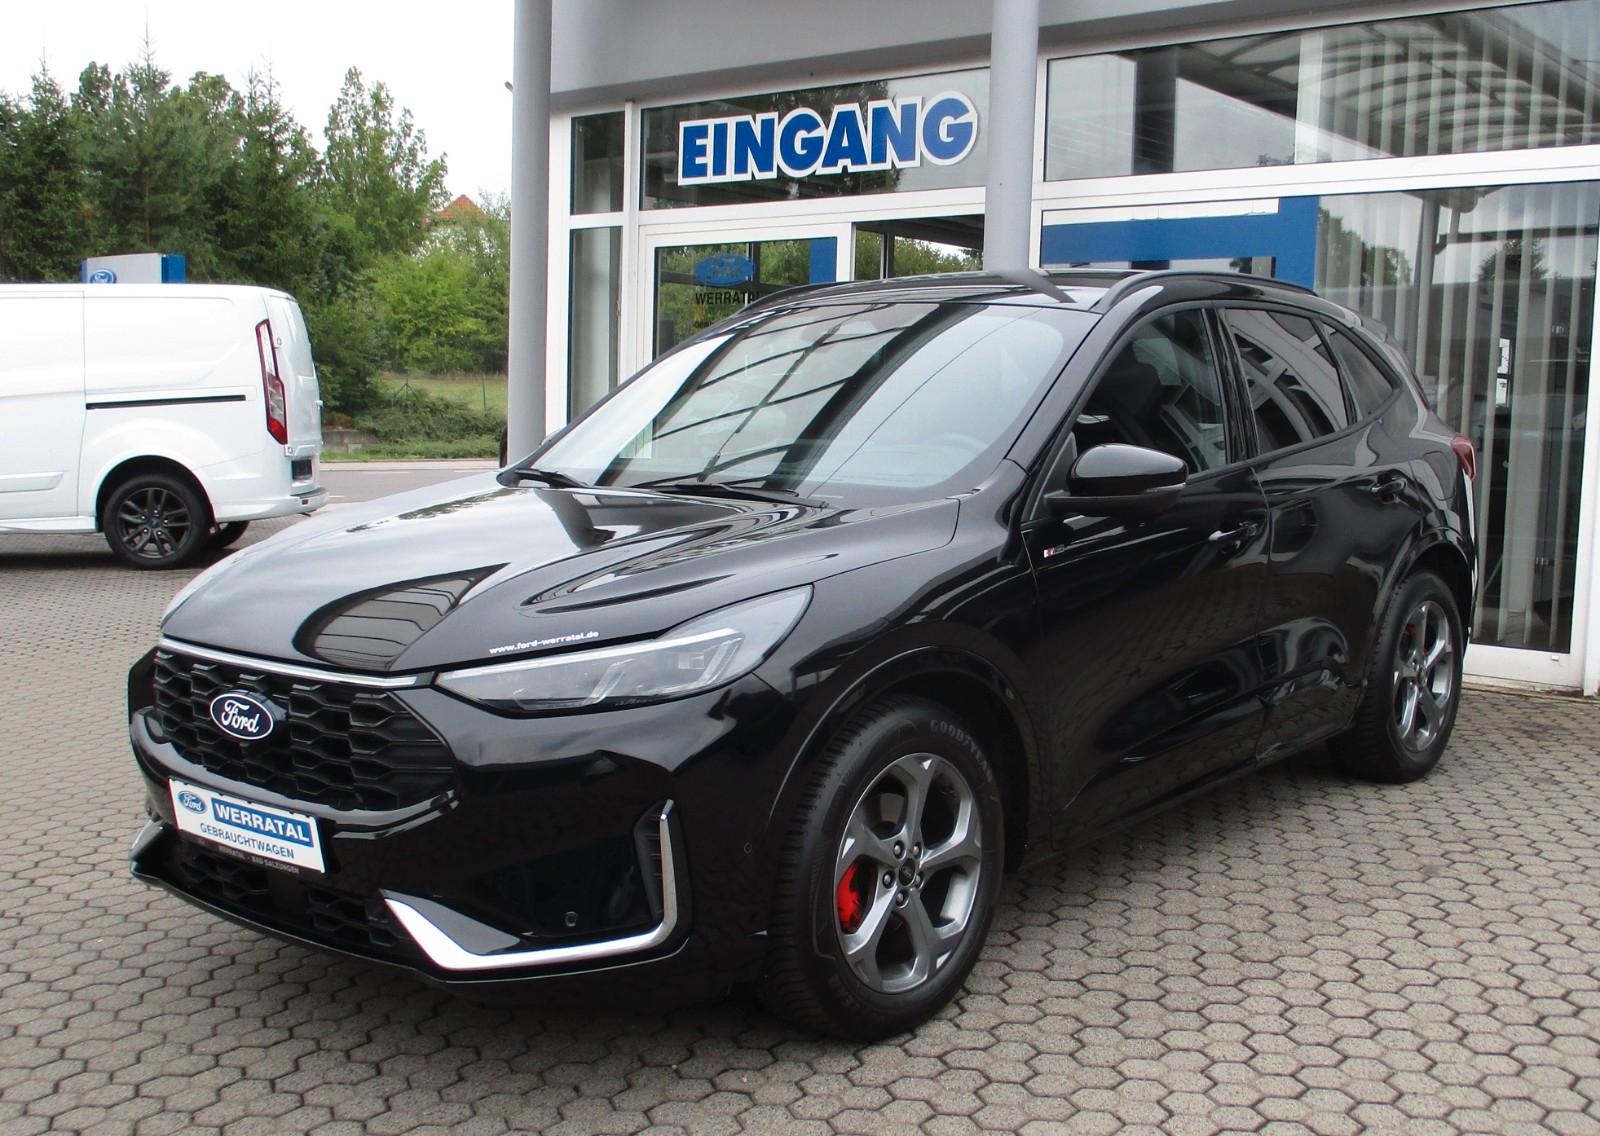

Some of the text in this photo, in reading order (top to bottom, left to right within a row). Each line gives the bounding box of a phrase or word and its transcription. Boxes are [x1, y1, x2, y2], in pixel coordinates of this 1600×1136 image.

[679, 91, 978, 186] EINGANG
[489, 631, 599, 654] www.ford-werratal.de
[221, 699, 260, 734] Ford
[182, 793, 310, 842] Ford WERRATAL
[200, 822, 295, 859] GEBRAUCHTWAGEN
